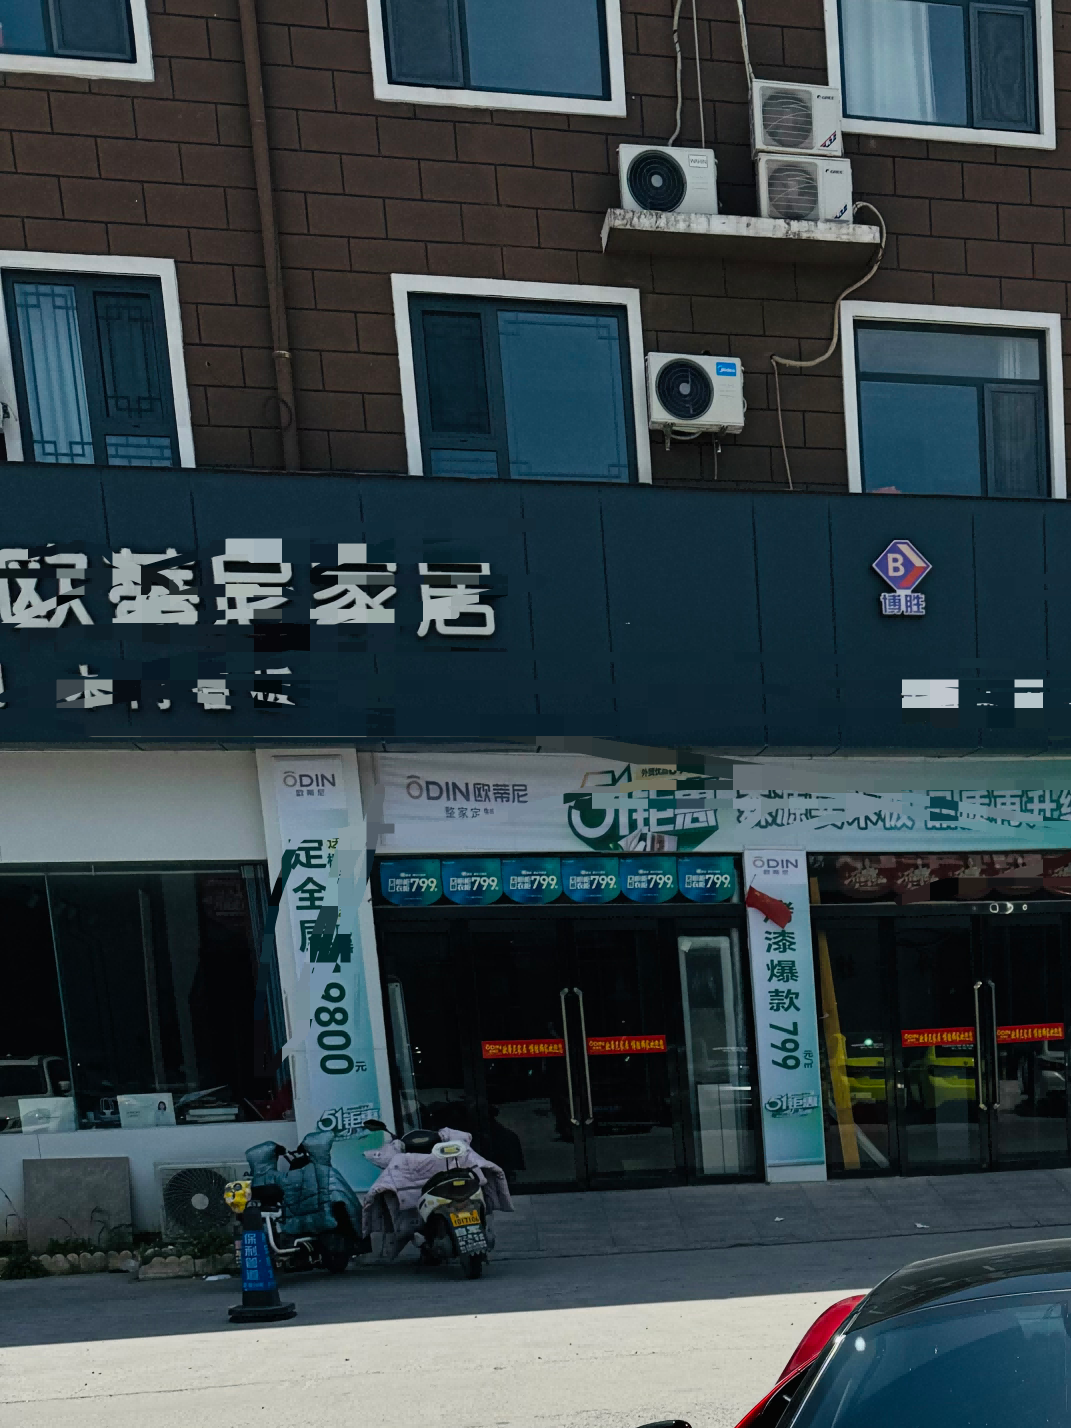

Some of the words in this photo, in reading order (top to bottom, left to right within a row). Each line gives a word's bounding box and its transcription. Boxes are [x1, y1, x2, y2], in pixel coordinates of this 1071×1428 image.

[887, 553, 905, 577] B
[880, 593, 926, 615] 博胜
[763, 900, 801, 1012] 漆爆款
[769, 1021, 801, 1071] 799
